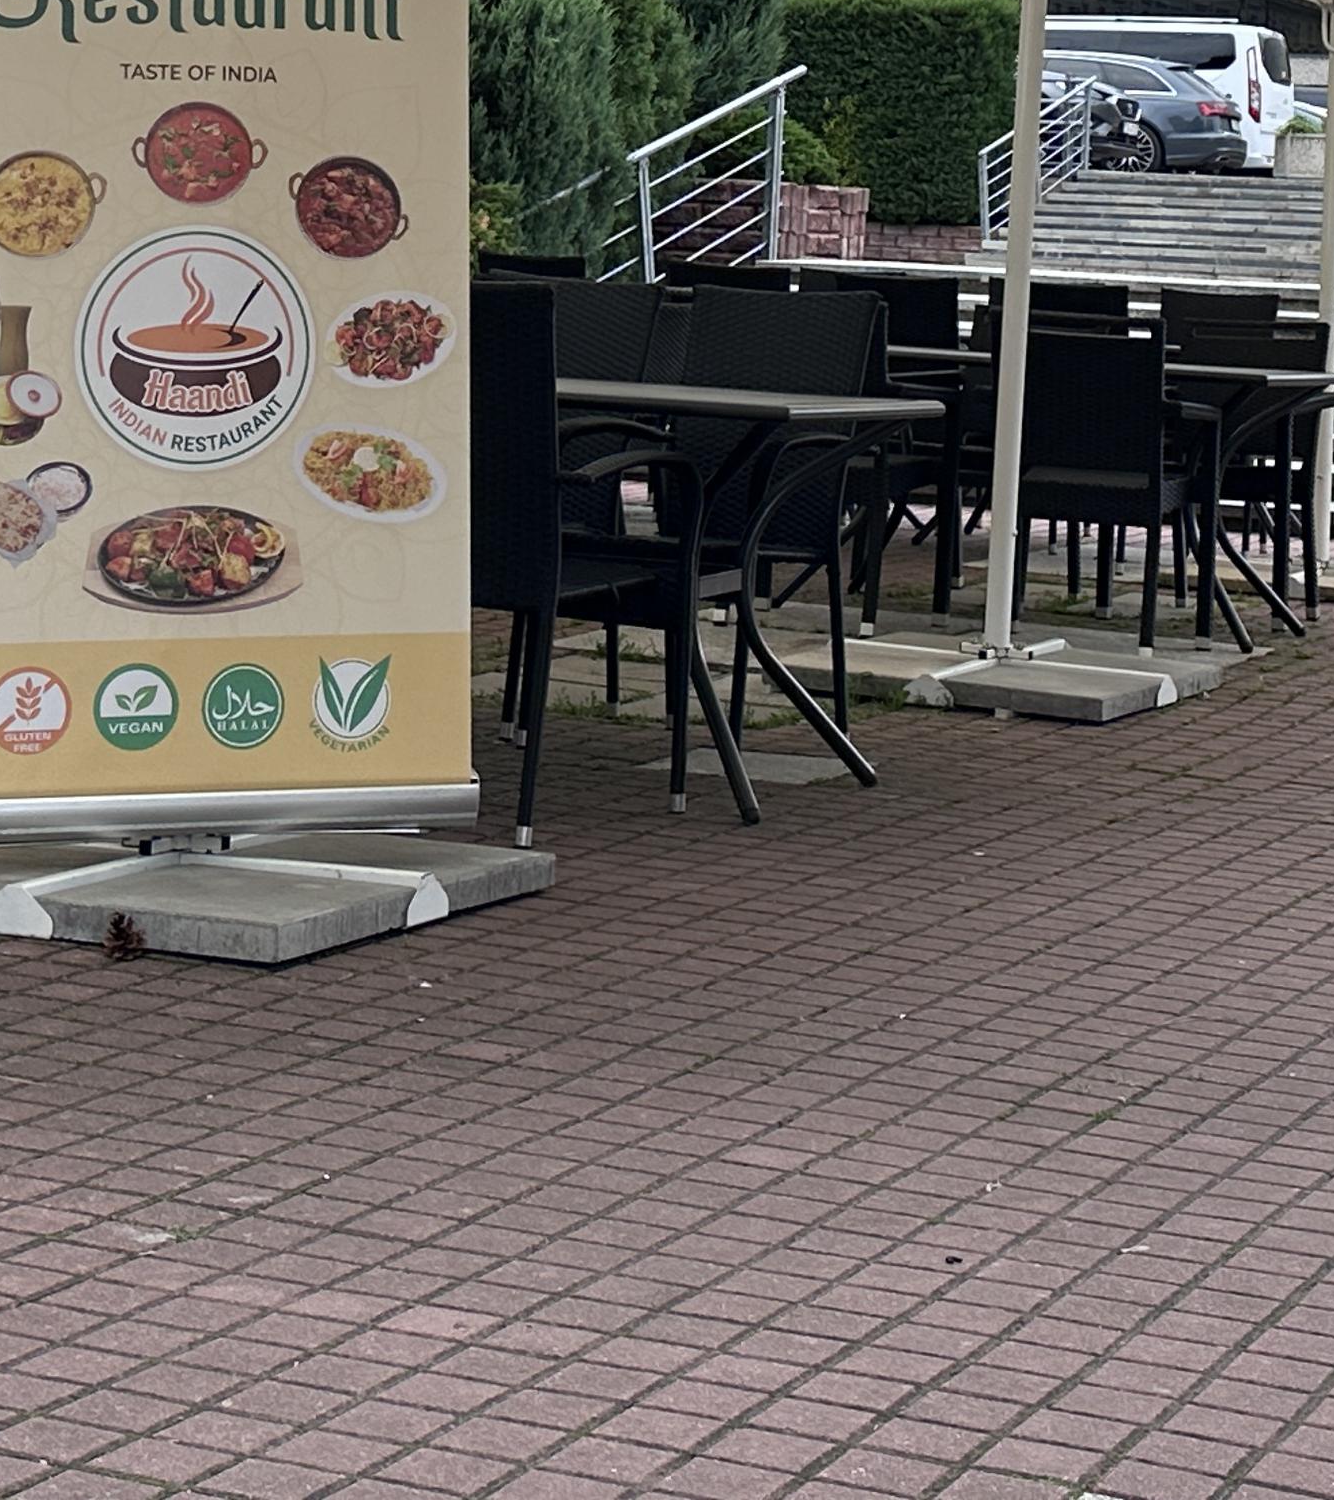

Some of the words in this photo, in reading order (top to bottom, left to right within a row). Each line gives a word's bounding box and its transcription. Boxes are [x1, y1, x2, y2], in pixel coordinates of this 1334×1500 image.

[120, 62, 182, 83] TASTE
[187, 64, 216, 83] OF
[221, 64, 277, 85] INDIA
[141, 368, 254, 412] Haandi
[108, 397, 168, 446] INDIAN
[170, 393, 284, 453] RESTAURANT
[212, 685, 276, 721] حلال
[3, 731, 52, 742] GLUTEN
[108, 721, 164, 736] VEGAN
[217, 719, 270, 732] HALAL
[308, 717, 391, 754] VEGETARIAN
[12, 743, 42, 753] FREE
